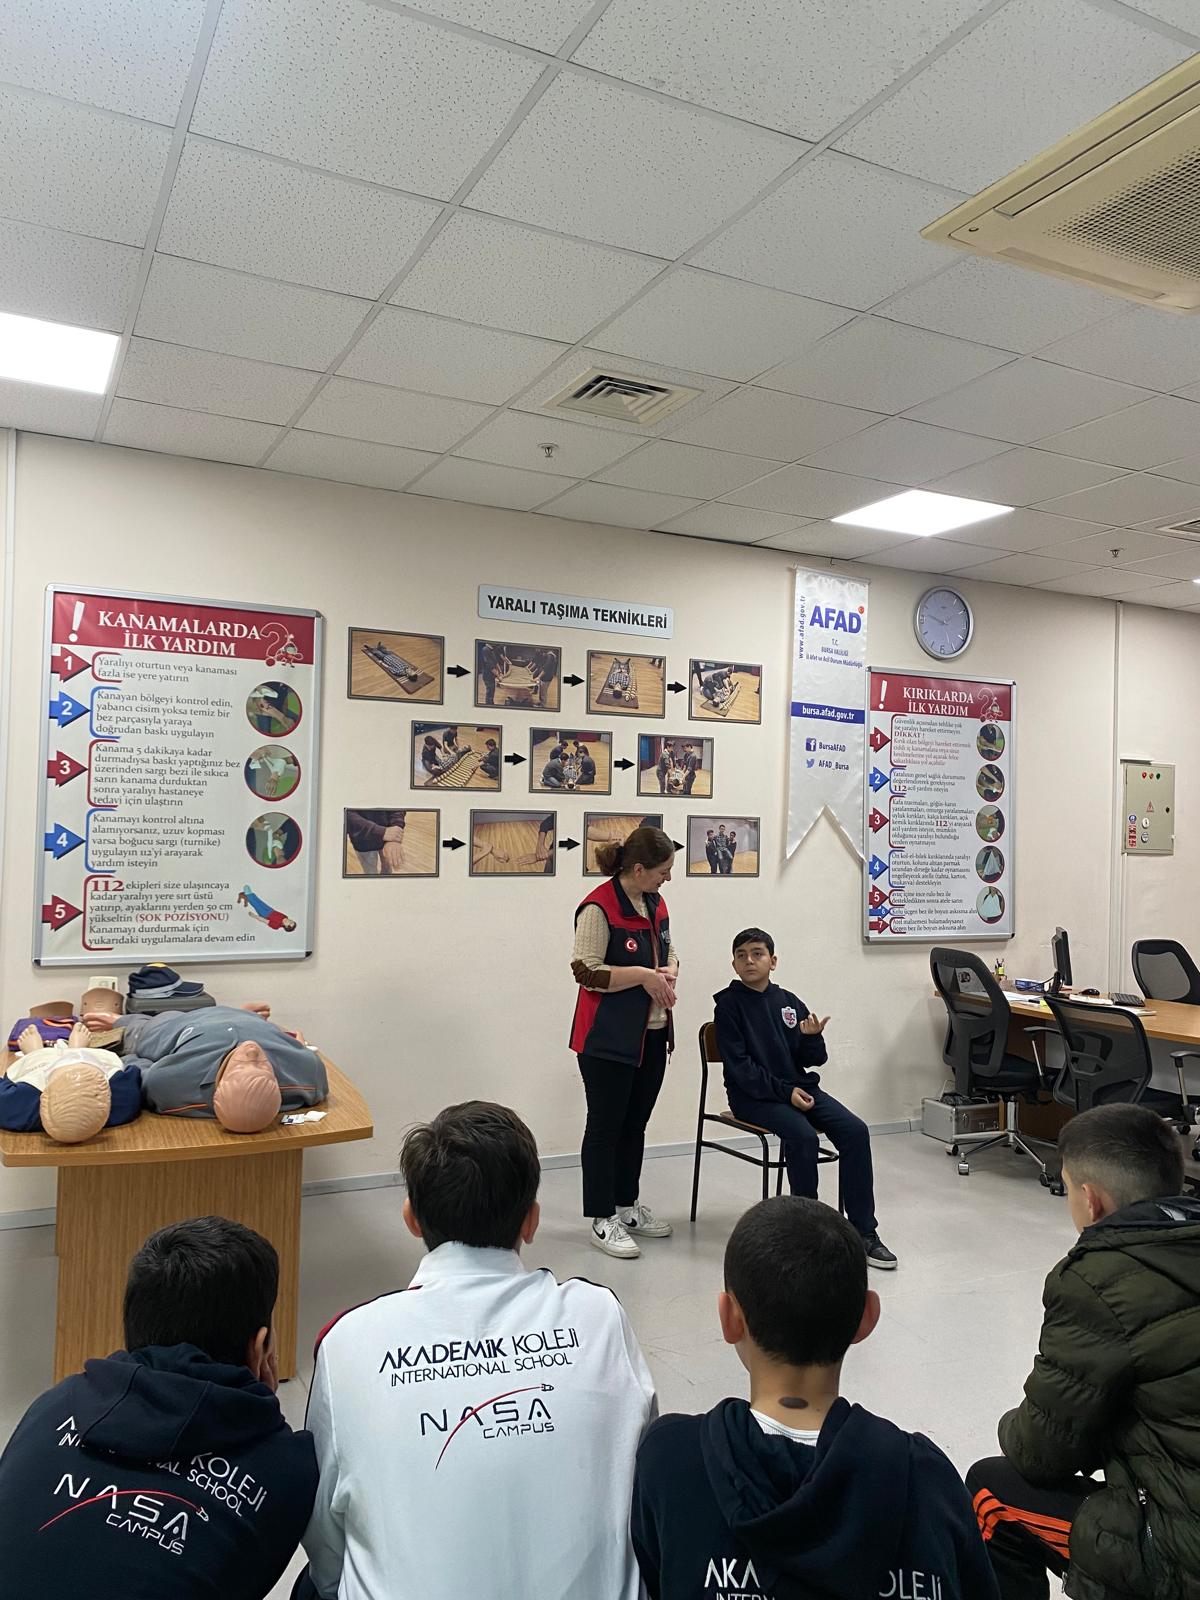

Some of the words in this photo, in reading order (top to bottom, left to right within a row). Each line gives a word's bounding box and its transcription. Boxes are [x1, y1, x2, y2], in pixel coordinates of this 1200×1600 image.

[487, 594, 536, 614] YARALI
[540, 601, 589, 620] TAŞIMA
[593, 608, 667, 629] TEKNİKLERİ
[98, 610, 261, 640] KANAMALARDA
[798, 595, 806, 659] www.afad.gov.tr
[809, 605, 862, 634] AFAD
[123, 630, 157, 649] İLK
[160, 636, 236, 656] YARDIM
[64, 655, 72, 671] 1
[98, 657, 133, 669] Yaralıyı
[135, 660, 171, 671] oturtun
[173, 664, 193, 674] veya
[195, 664, 237, 675] kanaması
[98, 668, 120, 677] fazla
[122, 670, 136, 679] ise
[137, 672, 157, 682] yere
[158, 672, 189, 683] yatırın
[97, 690, 138, 703] Kanayan
[140, 692, 173, 705] bölgeyi
[175, 695, 209, 706] kontrol
[210, 697, 233, 708] edin,
[903, 687, 974, 704] KIRIKLARDA
[61, 701, 73, 715] 2
[96, 701, 133, 713] yabancı
[135, 704, 160, 713] cisim
[162, 706, 187, 716] yoksa
[190, 708, 215, 717] temiz
[217, 709, 231, 718] bir
[802, 705, 855, 720] bursa.afad.gov.tr
[908, 700, 926, 713] İLK
[928, 703, 968, 716] YARDIM
[96, 713, 113, 721] bez
[115, 715, 161, 726] parçasıyla
[163, 719, 192, 729] yaraya
[95, 724, 142, 735] doğrudan
[144, 726, 168, 736] baskı
[170, 729, 215, 739] uygulayın
[876, 733, 881, 744] 1
[95, 744, 134, 753] Kanama
[136, 747, 142, 756] 5
[143, 746, 185, 757] dakikaya
[186, 747, 212, 757] kadar
[818, 742, 846, 752] BursaAFAD
[59, 760, 71, 775] 3
[94, 754, 150, 765] durmadıysa
[152, 756, 176, 765] baskı
[178, 758, 223, 769] yaptığınız
[225, 760, 241, 768] bez
[818, 760, 849, 770] AFAD_Bursa
[94, 765, 142, 774] üzerinden
[144, 768, 167, 777] sargı
[169, 767, 188, 776] bezi
[191, 768, 202, 777] ile
[203, 769, 229, 777] sıkıca
[874, 773, 880, 784] 2
[120, 776, 157, 785] kanama
[159, 777, 208, 786] durduktan
[121, 786, 156, 797] yaralıyı
[158, 787, 204, 798] hastaneye
[93, 796, 122, 804] tedavi
[125, 797, 142, 806] için
[144, 797, 183, 807] ulaştırın
[93, 814, 140, 825] Kanamayı
[142, 814, 177, 824] kontrol
[178, 816, 205, 825] altına
[874, 815, 880, 825] 3
[187, 826, 225, 837] kopması
[56, 832, 68, 847] 4
[119, 837, 154, 847] boğucu
[155, 839, 178, 847] sargı
[180, 838, 221, 848] (turnike)
[91, 847, 138, 857] uygulayın
[163, 848, 204, 858] arayarak
[91, 859, 125, 868] yardım
[127, 859, 158, 869] isteyin
[873, 861, 880, 872] 4
[91, 880, 125, 892] 112
[125, 881, 161, 891] ekipleri
[163, 881, 181, 889] size
[183, 881, 230, 891] ulaşıncaya
[90, 892, 117, 900] kadar
[118, 891, 153, 902] yaralıyı
[154, 893, 174, 902] yere
[193, 892, 214, 900] üstü
[874, 891, 880, 902] 5
[54, 904, 66, 919] 5
[89, 905, 123, 914] yatırıp,
[124, 903, 171, 913] ayaklarını
[173, 902, 204, 912] yerden
[206, 904, 218, 913] 50
[89, 914, 133, 924] yükseltin
[135, 914, 162, 923] (ŞOK
[164, 912, 229, 922] POZİSYONU)
[89, 925, 136, 935] Kanamayı
[138, 925, 191, 933] durdurmak
[192, 924, 210, 933] için
[88, 936, 139, 946] yukarıdaki
[141, 935, 203, 946] uygulamalara
[204, 934, 234, 942] devam
[235, 933, 256, 942] edin
[391, 1361, 510, 1387] INTERNATIONAL
[513, 1352, 573, 1372] SCHOOL
[420, 1398, 552, 1435] NASA
[482, 1422, 555, 1439] CAMPUS
[187, 1468, 243, 1517] SCHOOL
[54, 1473, 189, 1541] NASA
[105, 1513, 185, 1555] CAMPUS
